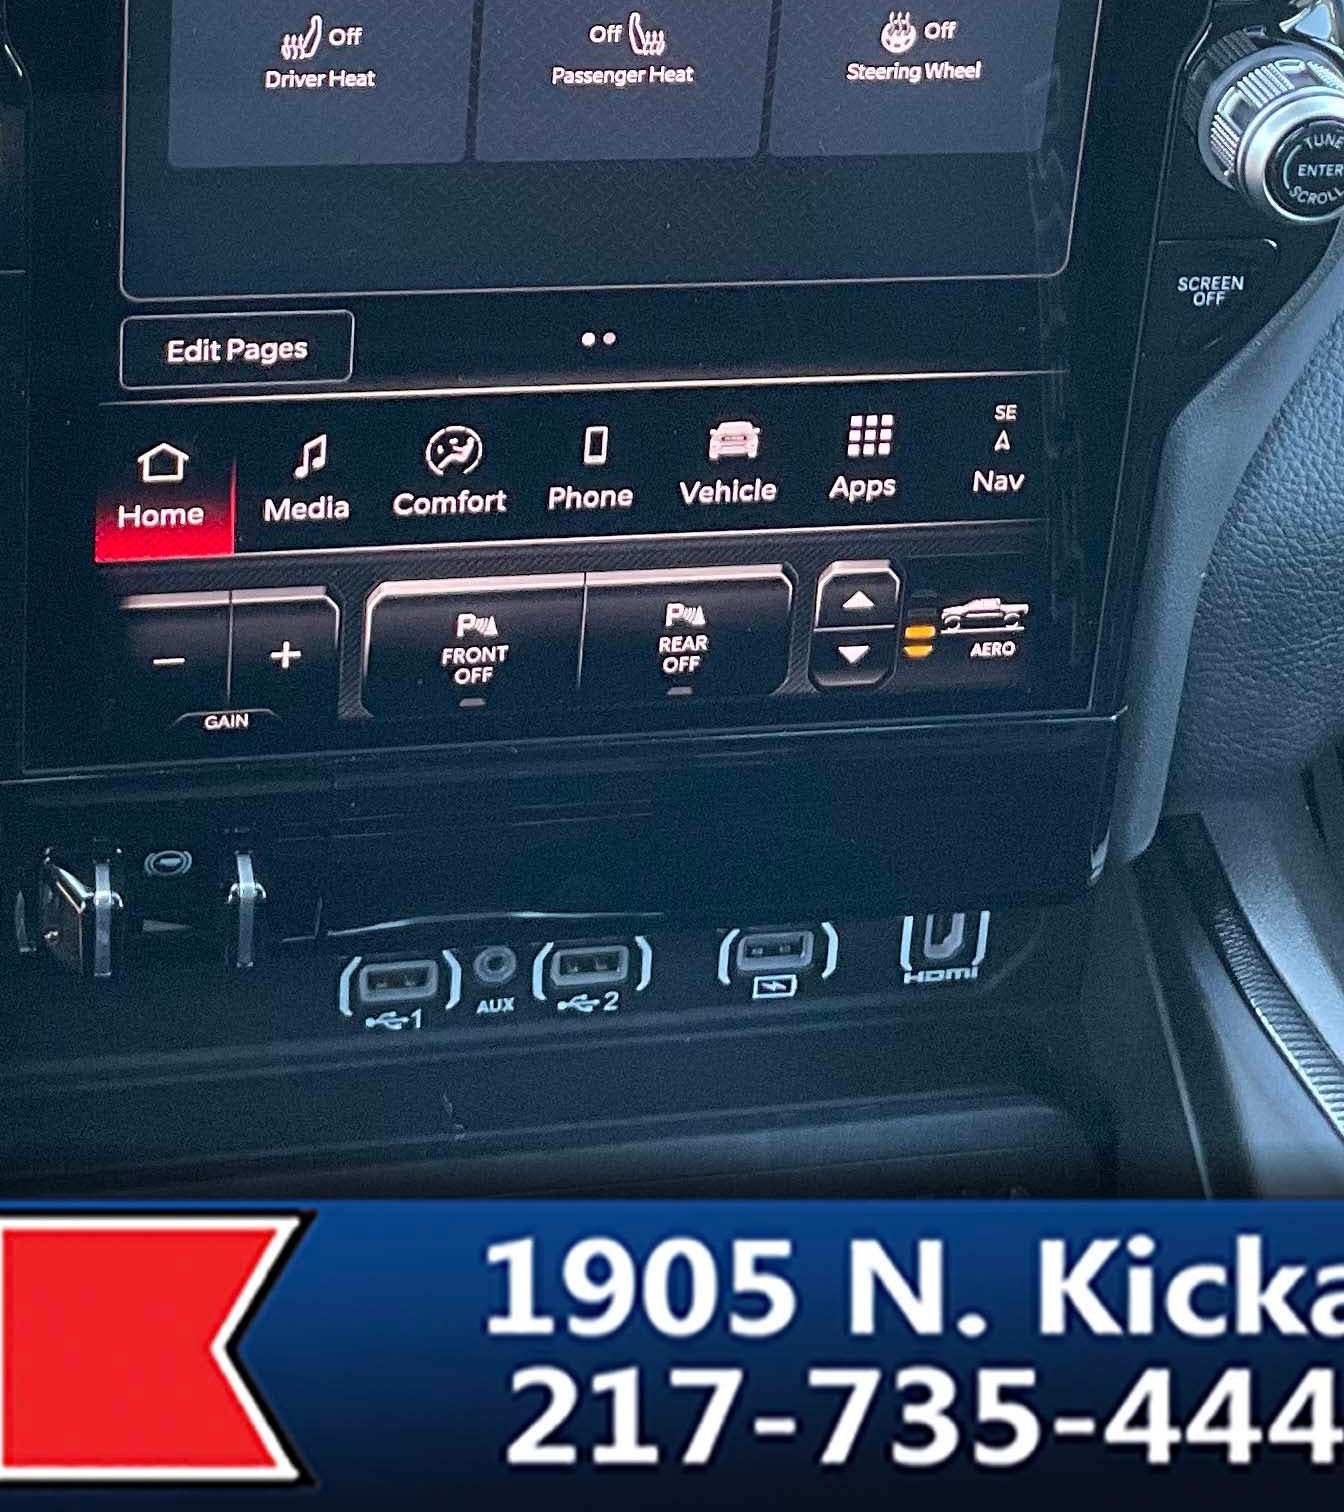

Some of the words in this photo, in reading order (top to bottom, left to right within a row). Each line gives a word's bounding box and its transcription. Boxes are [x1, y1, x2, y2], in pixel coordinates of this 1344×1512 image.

[328, 26, 362, 46] Off
[589, 24, 622, 44] Off
[922, 21, 955, 40] Off
[265, 68, 325, 88] Driver
[331, 68, 375, 86] Heat
[551, 66, 644, 89] Passenger
[650, 65, 693, 84] Heat
[846, 62, 920, 85] Steering
[925, 60, 981, 80] Wheel
[1298, 164, 1344, 177] ENTER
[1177, 276, 1244, 291] SCREEN
[1193, 292, 1225, 306] OFF
[167, 339, 220, 362] Edit
[226, 338, 308, 366] Pages
[994, 404, 1017, 421] SE
[828, 475, 896, 503] Apps
[972, 470, 1025, 492] Nav
[548, 486, 633, 510] Phone
[680, 478, 777, 505] Vehicle
[263, 496, 350, 522] Media
[392, 489, 506, 517] Comfort
[118, 505, 204, 528] Home
[658, 635, 708, 654] REAR
[970, 641, 1016, 658] AERO
[441, 645, 508, 667] FRONT
[662, 655, 700, 674] OFF
[453, 666, 493, 685] OFF
[204, 713, 249, 730] GAIN
[476, 997, 515, 1014] AUX
[604, 991, 619, 1011] 2
[412, 1009, 422, 1029] 1
